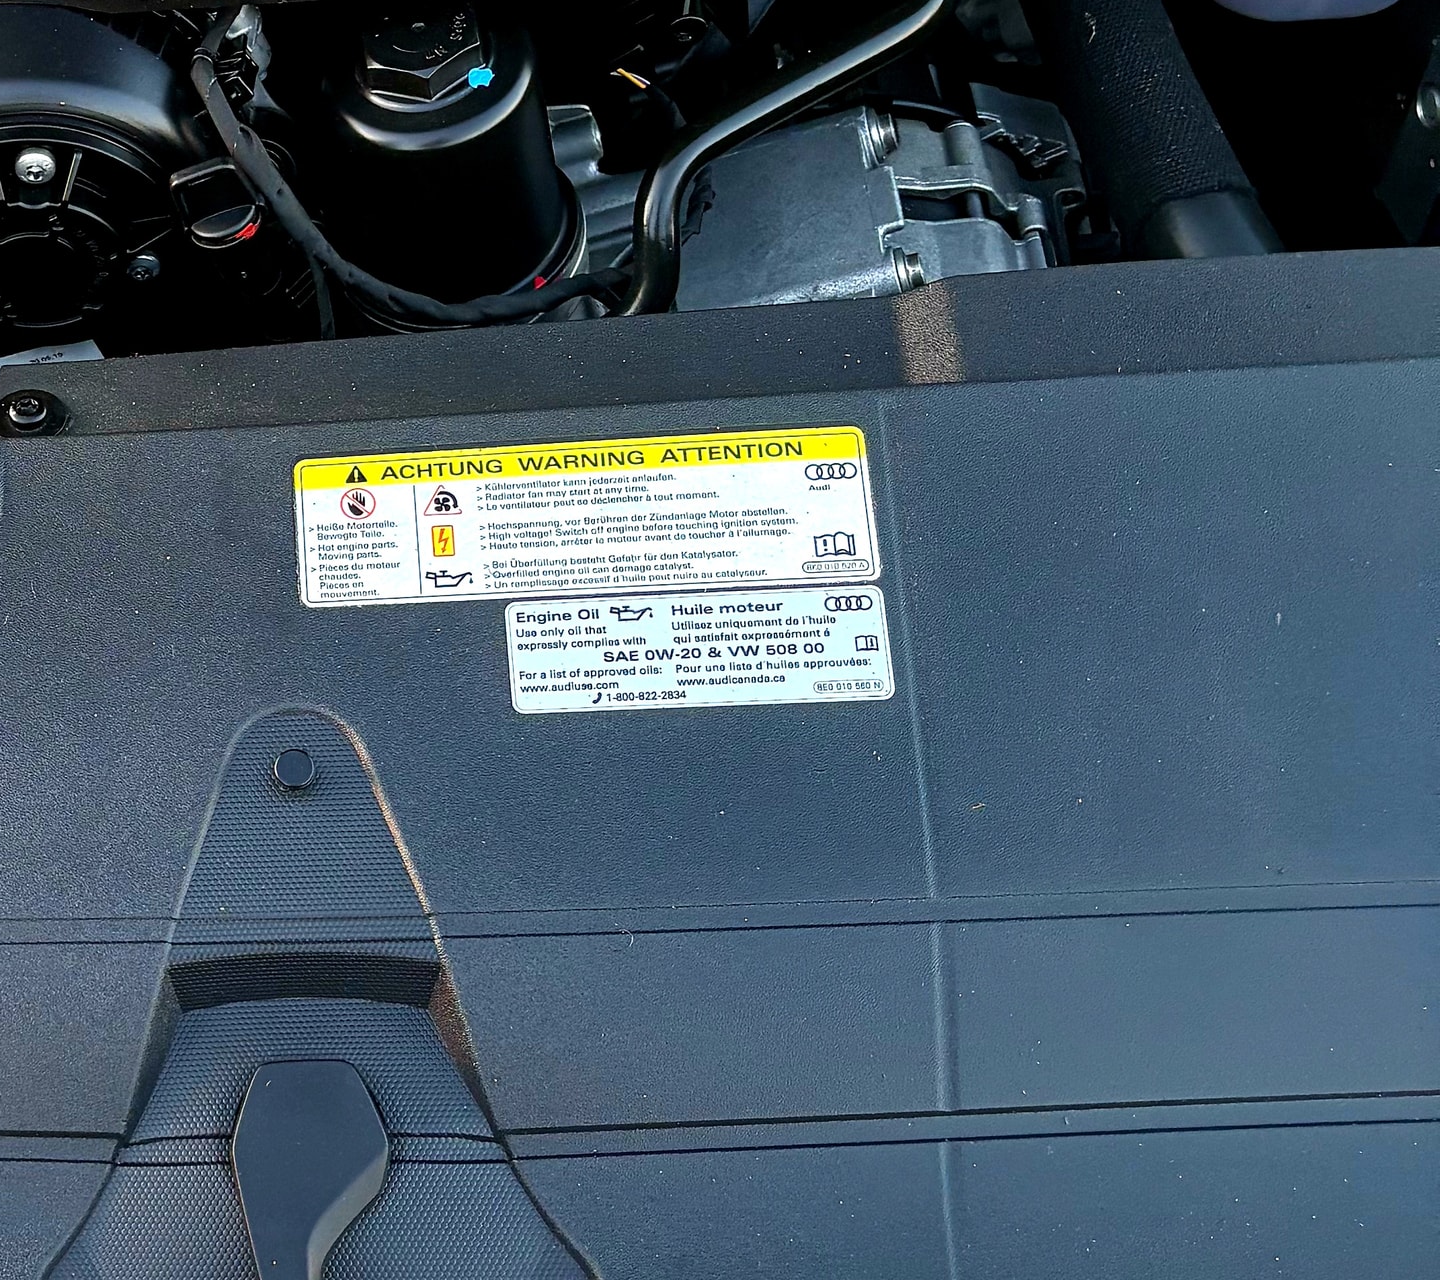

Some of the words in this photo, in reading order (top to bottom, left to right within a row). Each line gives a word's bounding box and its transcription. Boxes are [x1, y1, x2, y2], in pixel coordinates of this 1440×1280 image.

[380, 459, 503, 481] ACHTUNG
[517, 451, 645, 472] WARNING
[660, 441, 803, 464] ATTENTION
[670, 603, 713, 615] Huile
[718, 602, 783, 613] moteur
[515, 611, 572, 623] Engine
[577, 608, 599, 619] Oil
[671, 620, 712, 630] Utilisez
[714, 618, 782, 628] uniquement
[784, 616, 799, 625] de
[515, 628, 537, 637] Use
[539, 627, 564, 637] only
[567, 625, 581, 635] oil
[584, 626, 607, 634] that
[516, 640, 568, 651] expressly
[570, 637, 620, 648] complies
[622, 636, 646, 645] with
[672, 633, 691, 644] qui
[603, 650, 639, 662] SAE
[644, 647, 701, 660] 0W-20
[707, 646, 721, 657] &
[726, 645, 759, 656] VW
[765, 643, 797, 655] 508
[802, 642, 824, 653] 00
[518, 670, 537, 679] For
[549, 669, 566, 678] list
[568, 668, 580, 677] of
[583, 666, 636, 678] approved
[639, 665, 662, 674] oils:
[675, 664, 701, 673] Pour
[704, 664, 725, 672] une
[728, 661, 752, 670] liste
[676, 675, 785, 685] www.audicanada.ca
[835, 682, 852, 690] 010
[606, 690, 686, 701] 1-800-822-2834
